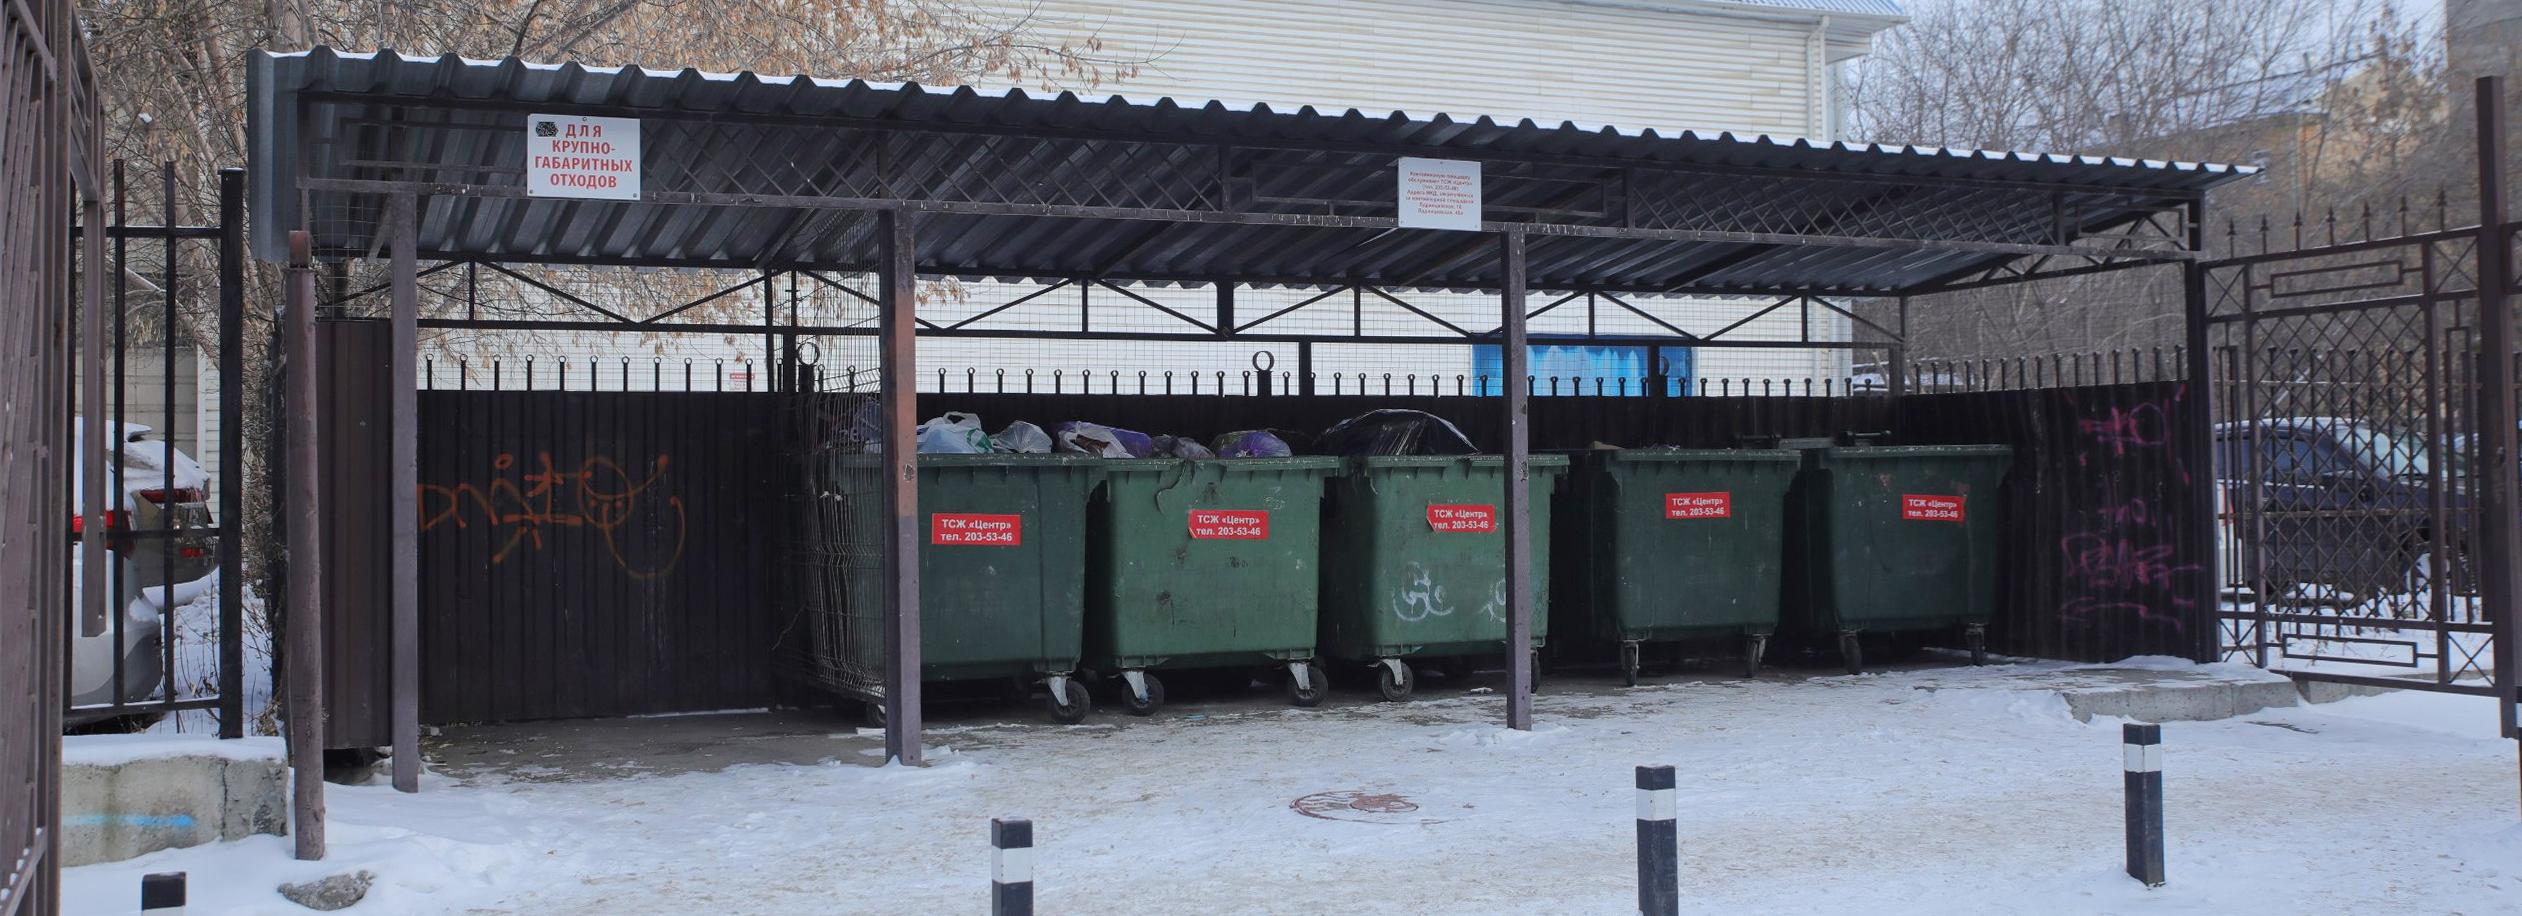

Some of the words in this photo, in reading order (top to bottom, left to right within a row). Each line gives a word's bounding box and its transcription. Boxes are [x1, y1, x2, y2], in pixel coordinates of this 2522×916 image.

[565, 124, 602, 138] ДЛЯ
[552, 140, 616, 154] КРУПНО-
[535, 156, 632, 172] ГАБАРИТНЫХ
[550, 173, 617, 189] ОТХОДОВ
[1672, 497, 1691, 506] ТСЖ
[1434, 509, 1453, 518] ТСЖ
[1689, 507, 1725, 516] 203-53-46
[942, 519, 966, 529] ТСЖ
[968, 519, 1012, 531] «Центр»
[1197, 515, 1219, 524] ТСЖ
[1221, 515, 1260, 526] «Центр»
[1452, 520, 1489, 529] 203-53-46
[1196, 527, 1215, 535] тел.
[1218, 527, 1261, 536] 203-53-46
[941, 533, 962, 541] тел.
[965, 532, 1013, 542] 203-53-46
